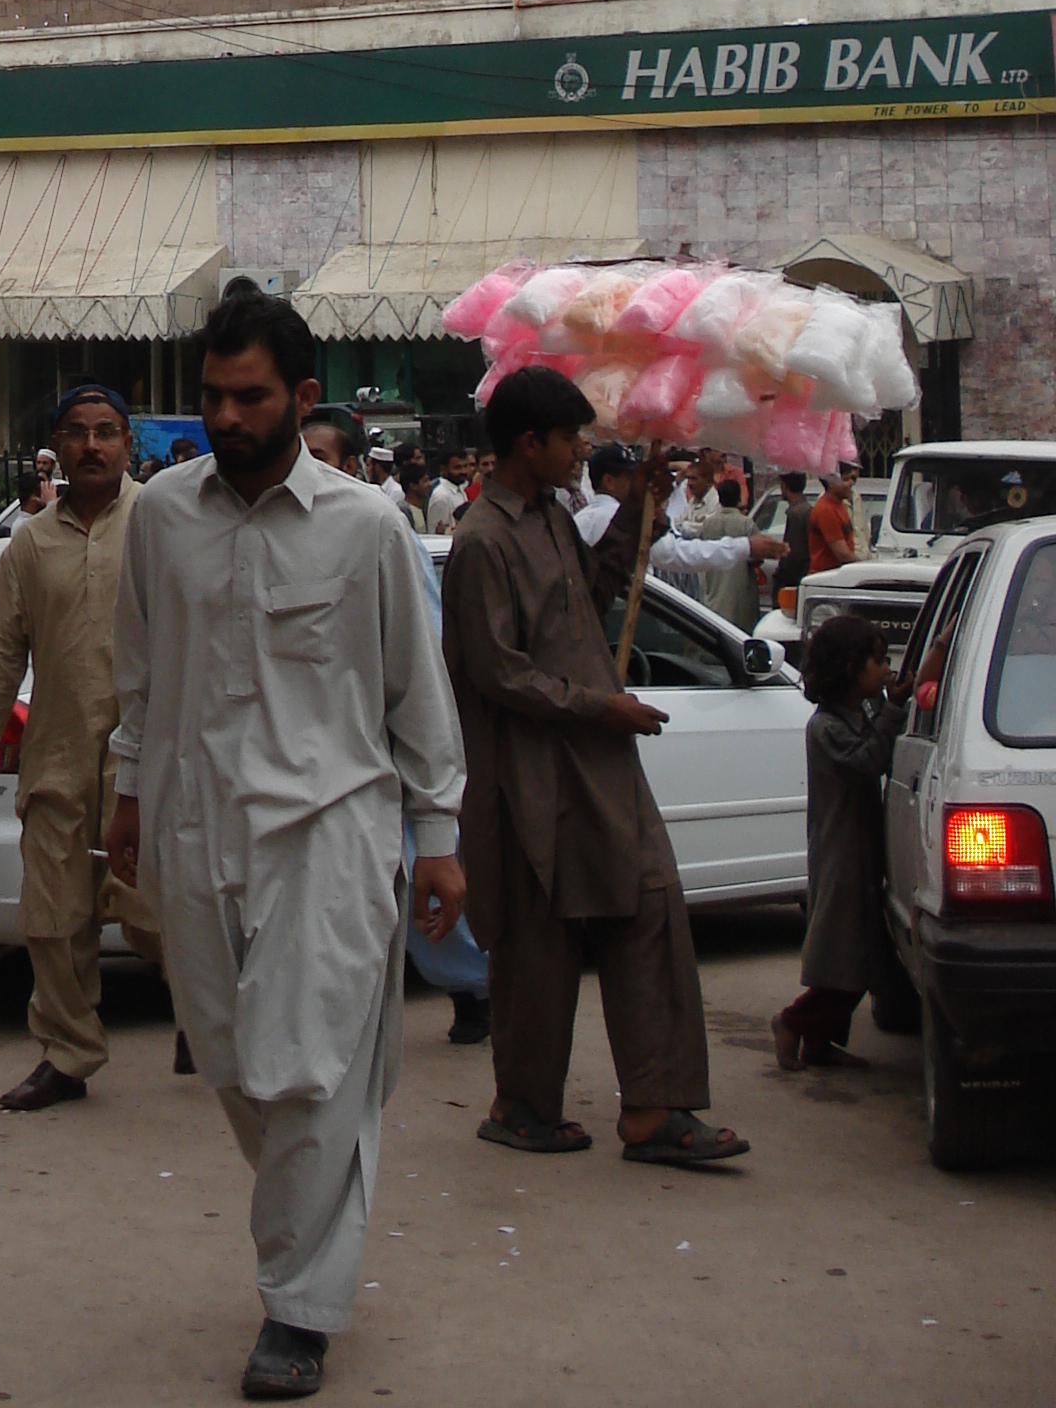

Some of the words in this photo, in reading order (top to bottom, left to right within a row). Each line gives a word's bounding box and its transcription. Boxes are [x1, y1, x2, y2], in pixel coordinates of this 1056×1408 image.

[621, 41, 801, 100] HABIB
[825, 31, 999, 90] BANK
[1001, 69, 1030, 84] LTD
[874, 106, 897, 117] THE
[905, 103, 949, 116] POWER
[964, 103, 980, 113] TO
[994, 101, 1026, 112] LEAD
